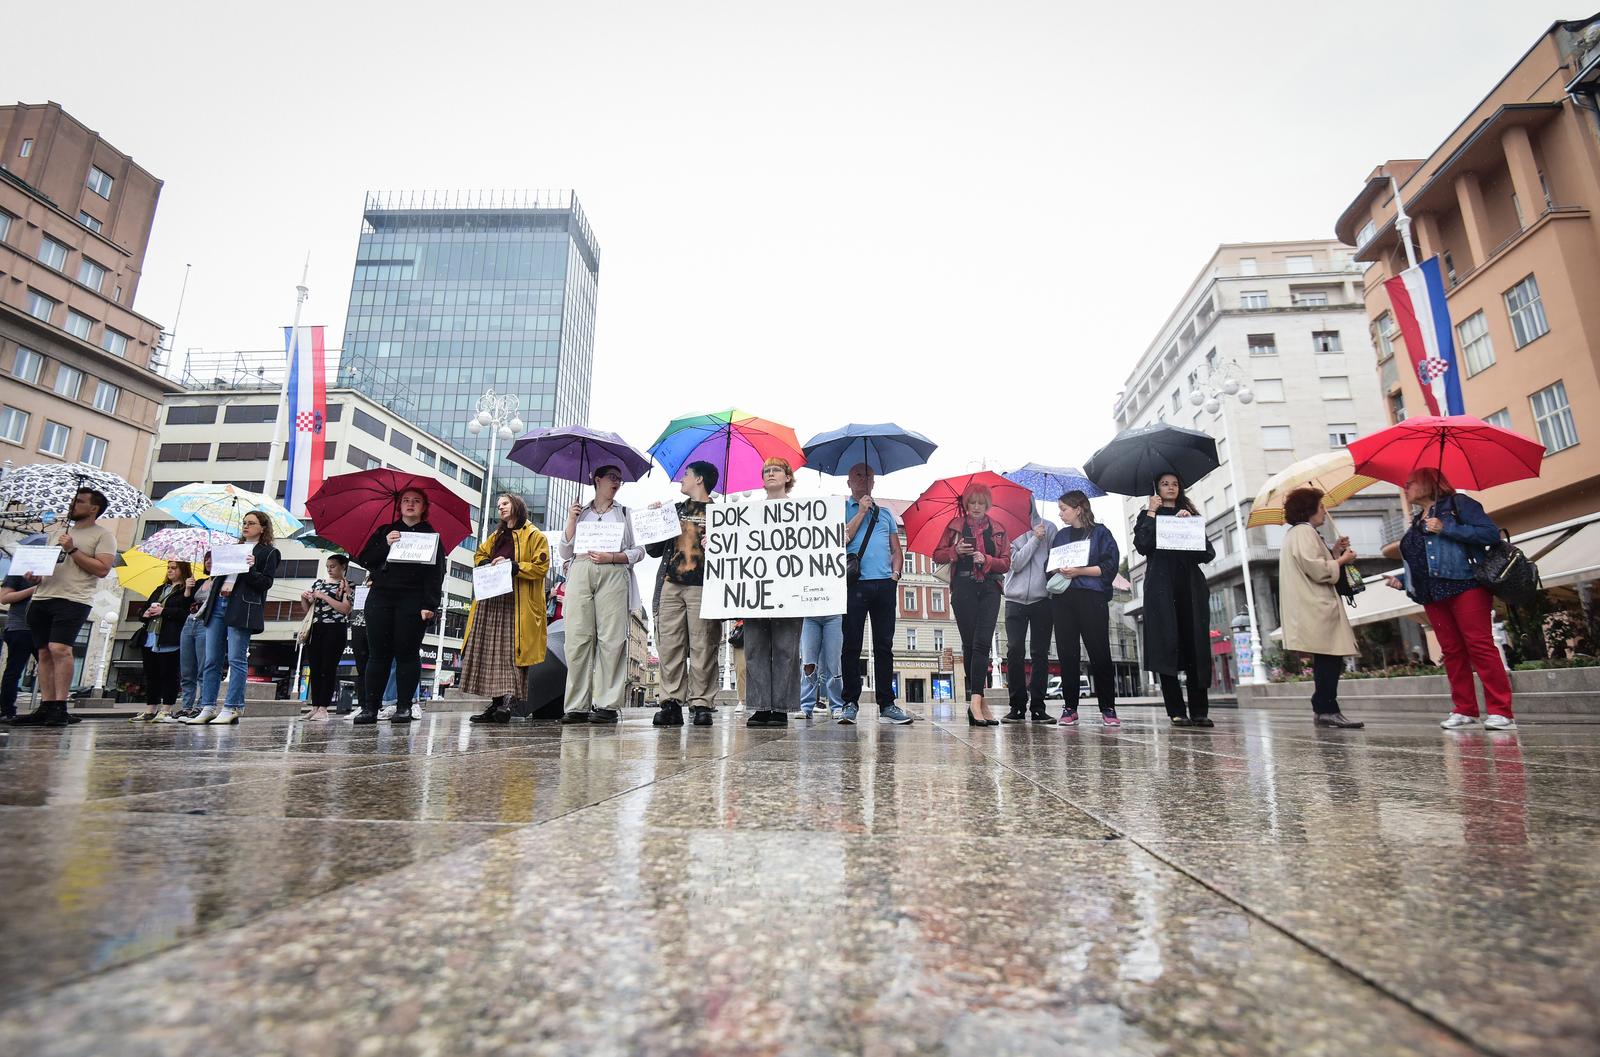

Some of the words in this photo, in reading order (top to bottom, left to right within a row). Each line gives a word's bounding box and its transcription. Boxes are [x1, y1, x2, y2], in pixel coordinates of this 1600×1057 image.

[712, 505, 750, 528] DOK
[764, 500, 827, 524] NISMO
[709, 533, 737, 554] SVI
[746, 523, 845, 551] SLOBODNI
[707, 556, 767, 580] NITKO
[777, 555, 803, 577] OD
[810, 553, 845, 578] NAS
[724, 580, 784, 610] NIJE.
[803, 585, 824, 593] Emma
